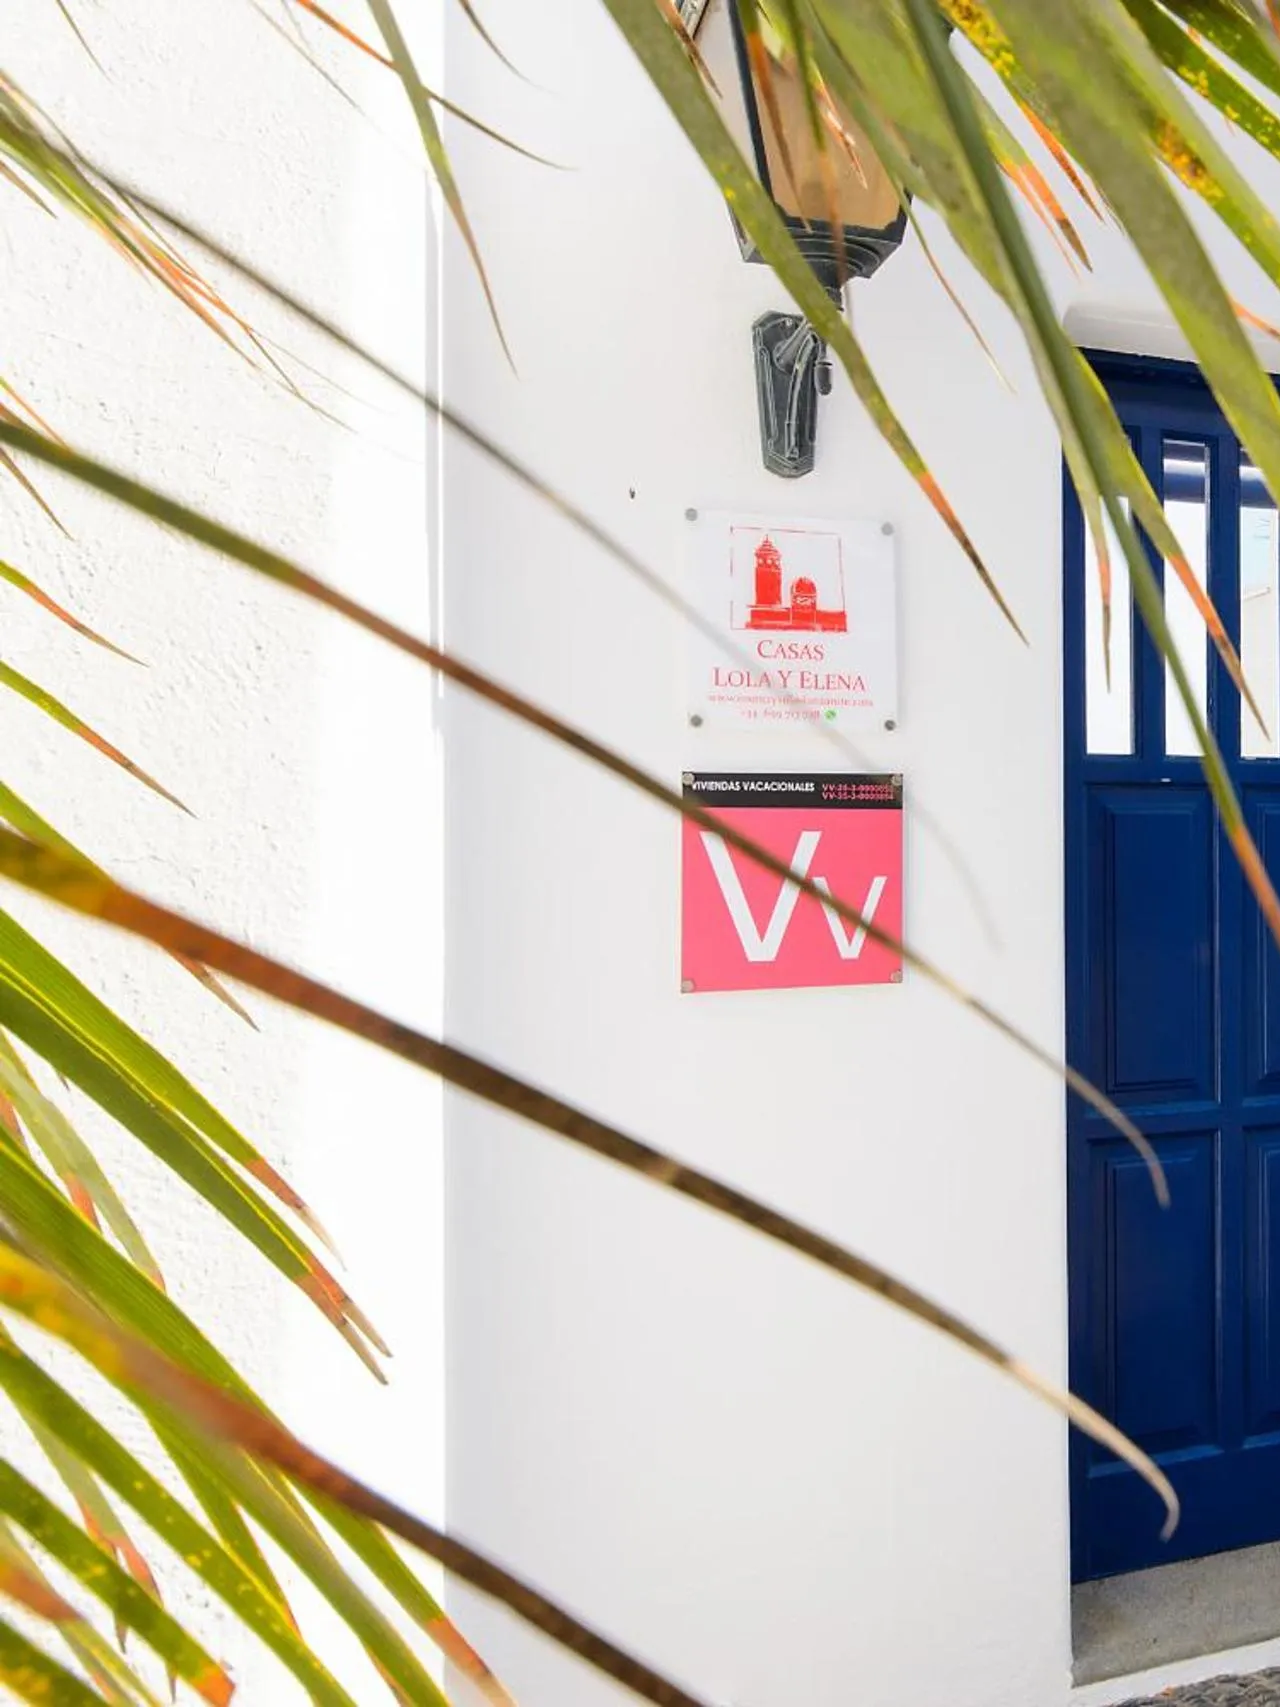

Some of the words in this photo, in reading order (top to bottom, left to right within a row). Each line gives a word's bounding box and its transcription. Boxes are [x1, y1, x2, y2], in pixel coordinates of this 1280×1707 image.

[757, 639, 825, 661] CASAS
[713, 667, 772, 688] LOLA
[777, 670, 793, 689] Y
[799, 671, 866, 692] ELENA
[741, 781, 815, 793] VACACIONALES
